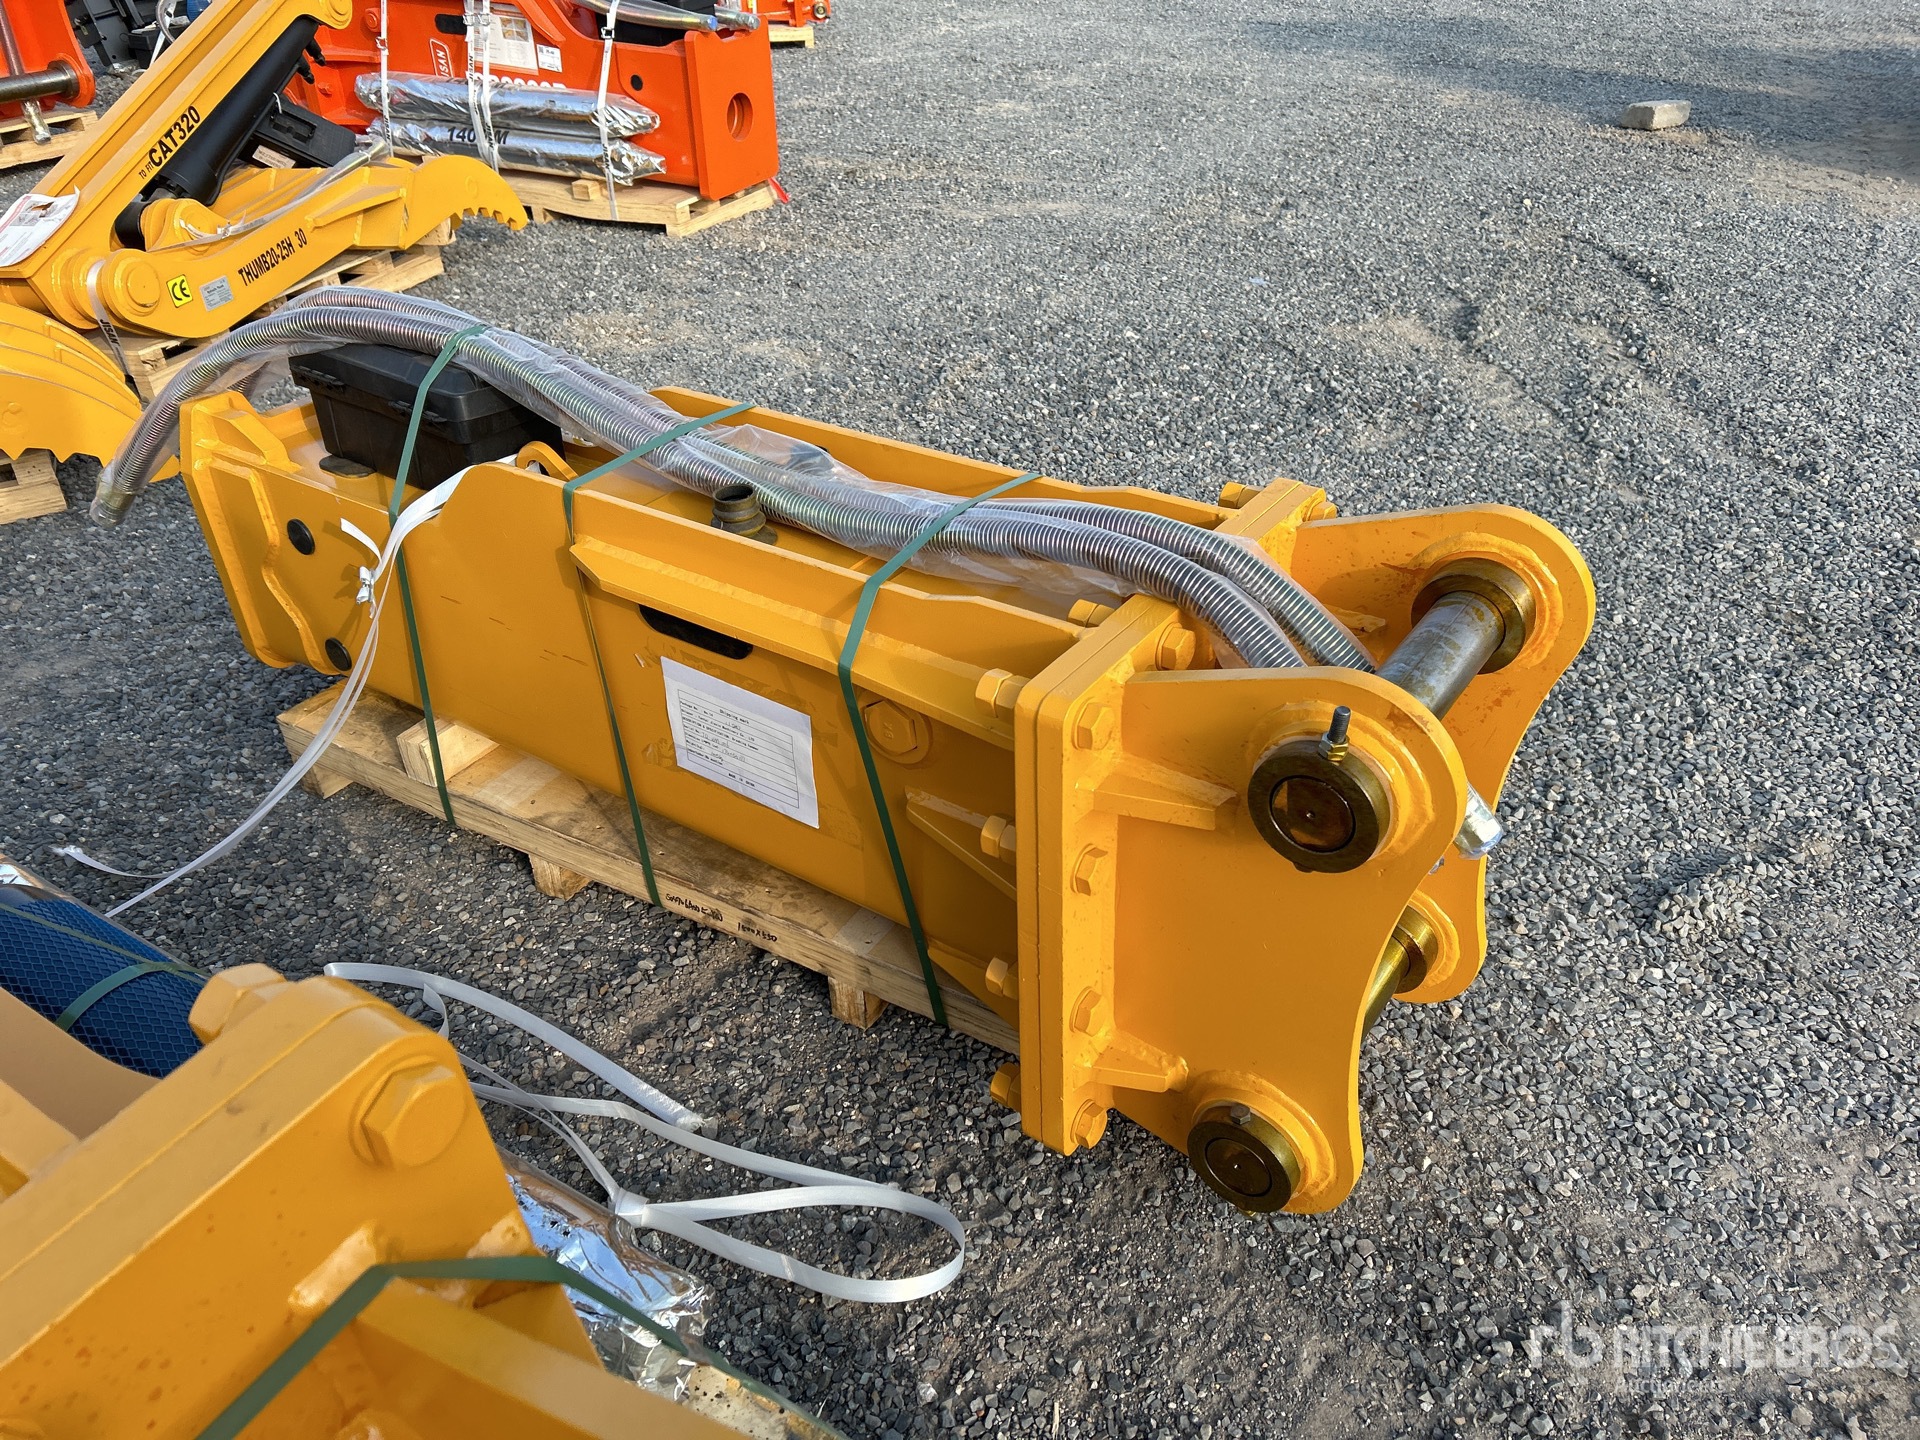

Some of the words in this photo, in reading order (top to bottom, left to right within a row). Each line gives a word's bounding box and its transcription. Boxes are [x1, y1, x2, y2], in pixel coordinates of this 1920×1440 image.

[436, 49, 450, 77] ISAN
[148, 105, 200, 168] CAT320
[145, 160, 155, 173] FIT
[601, 142, 612, 170] JISAN
[138, 169, 147, 180] TO
[237, 236, 296, 287] THUMB20-25H
[295, 228, 308, 248] 30
[99, 318, 121, 347] JISAN
